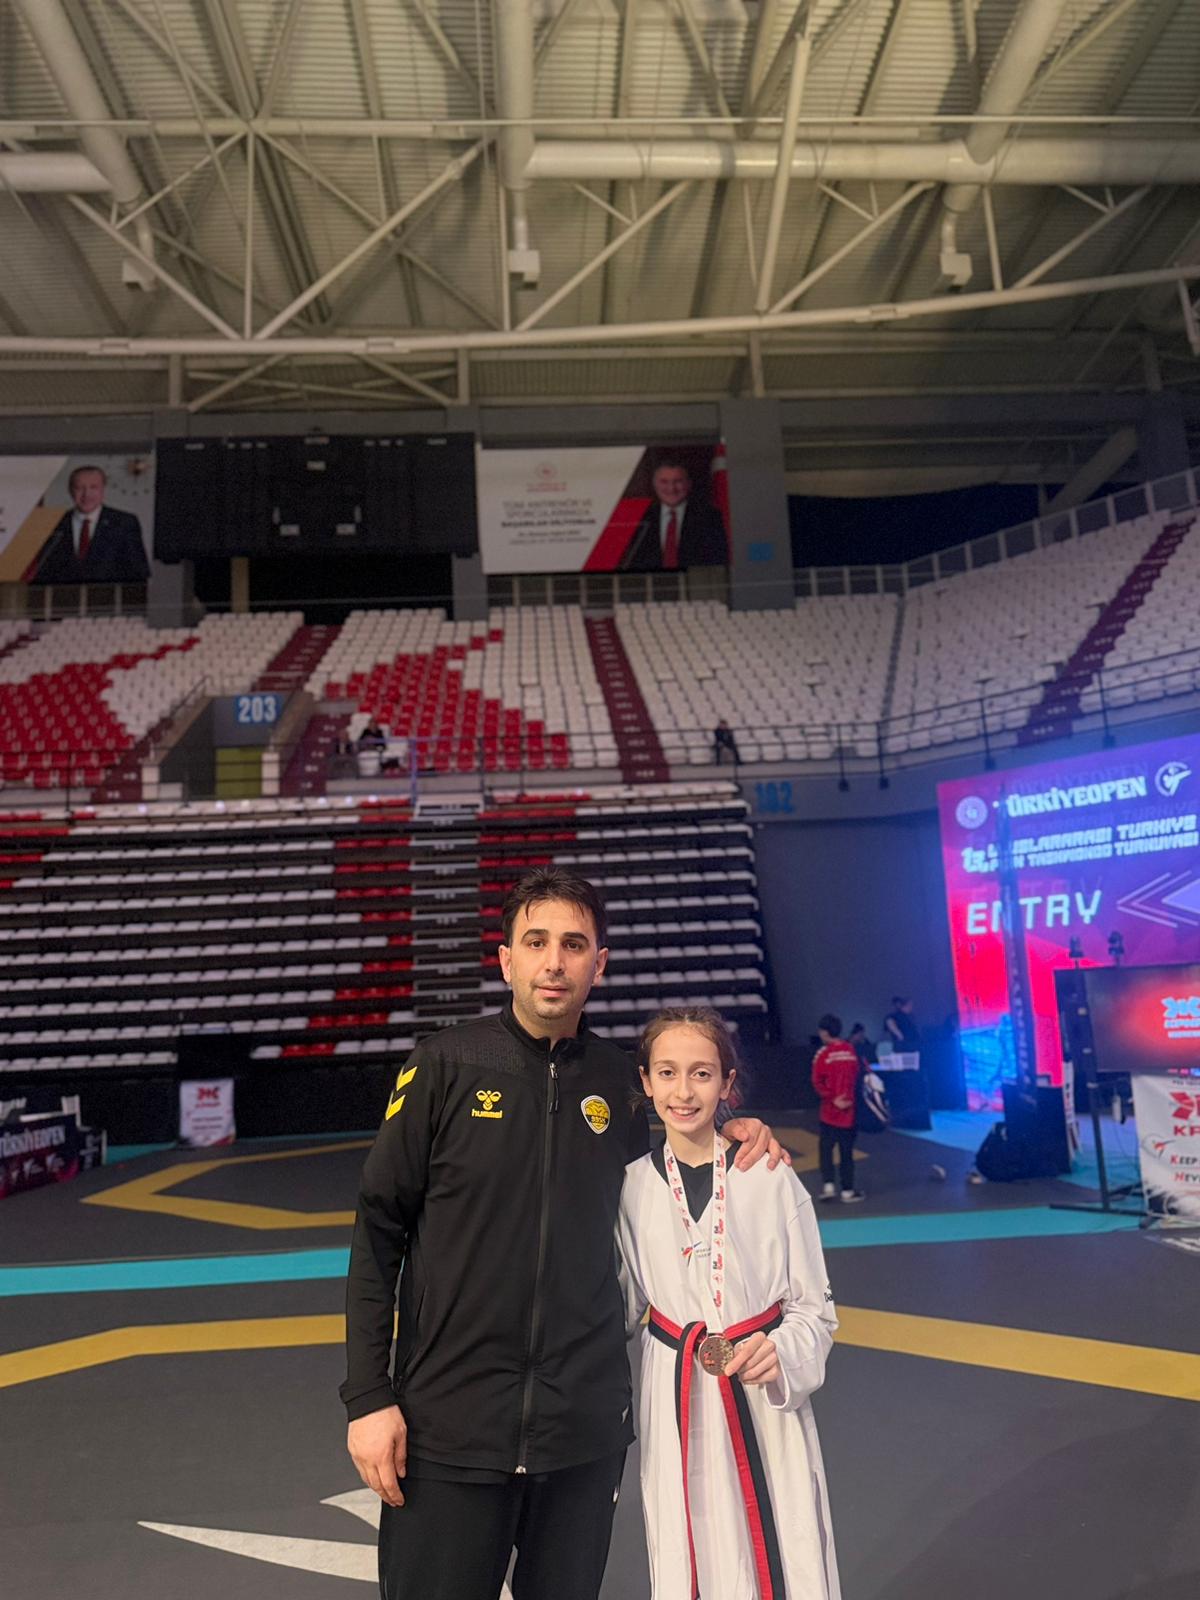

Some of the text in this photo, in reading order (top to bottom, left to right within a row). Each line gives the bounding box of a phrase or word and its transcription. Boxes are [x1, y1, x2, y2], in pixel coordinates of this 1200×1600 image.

[238, 696, 276, 722] 203
[993, 775, 1147, 818] ÜRKİYEOPEN
[471, 1108, 503, 1119] hummel
